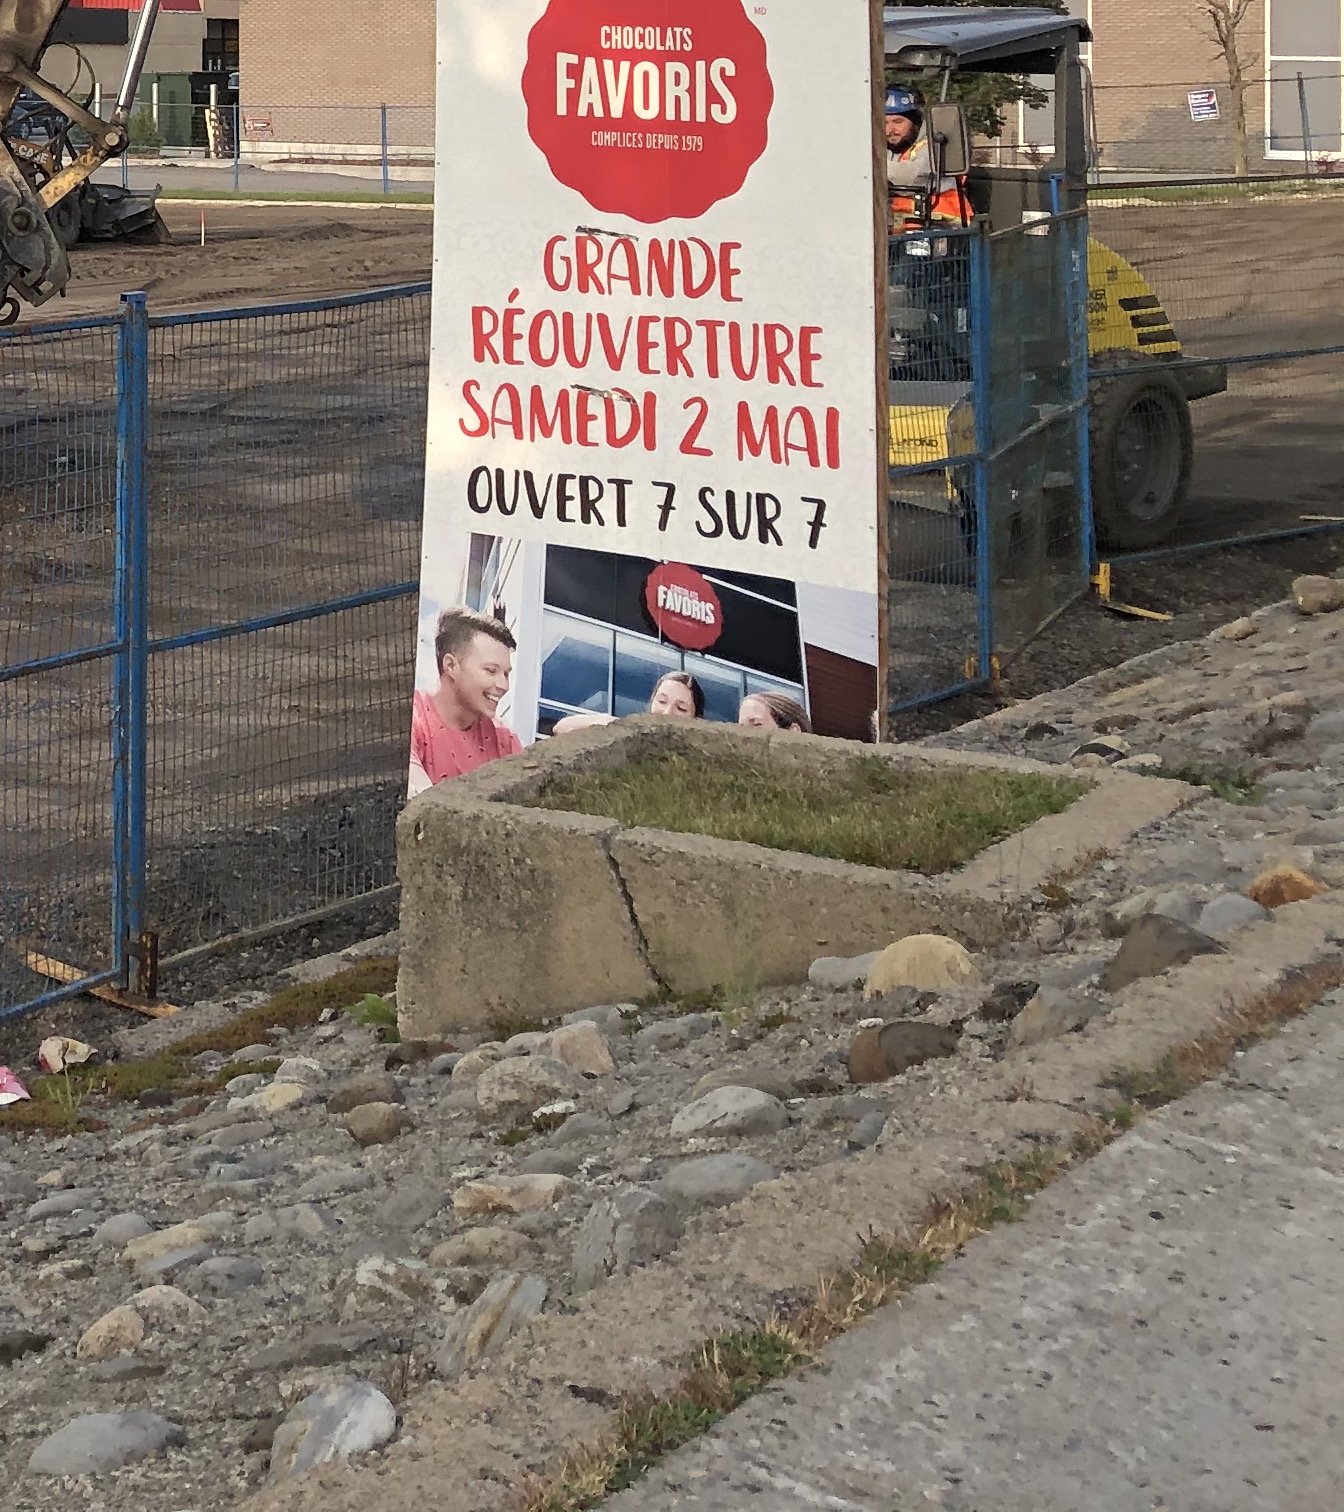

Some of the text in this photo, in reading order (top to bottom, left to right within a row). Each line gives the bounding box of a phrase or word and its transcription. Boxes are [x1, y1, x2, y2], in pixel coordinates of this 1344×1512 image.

[600, 25, 693, 52] CHOCOLATS
[556, 51, 738, 125] FAVORIS
[591, 130, 703, 152] COMPLICES DEPUIS 1979
[543, 235, 743, 303] GRANDE
[471, 288, 824, 388] RÉOUVERTURE
[458, 379, 841, 470] SAMEDI 2 MAI
[467, 465, 828, 551] OUVERT 7 SUR 7
[657, 584, 716, 625] FAVORIS
